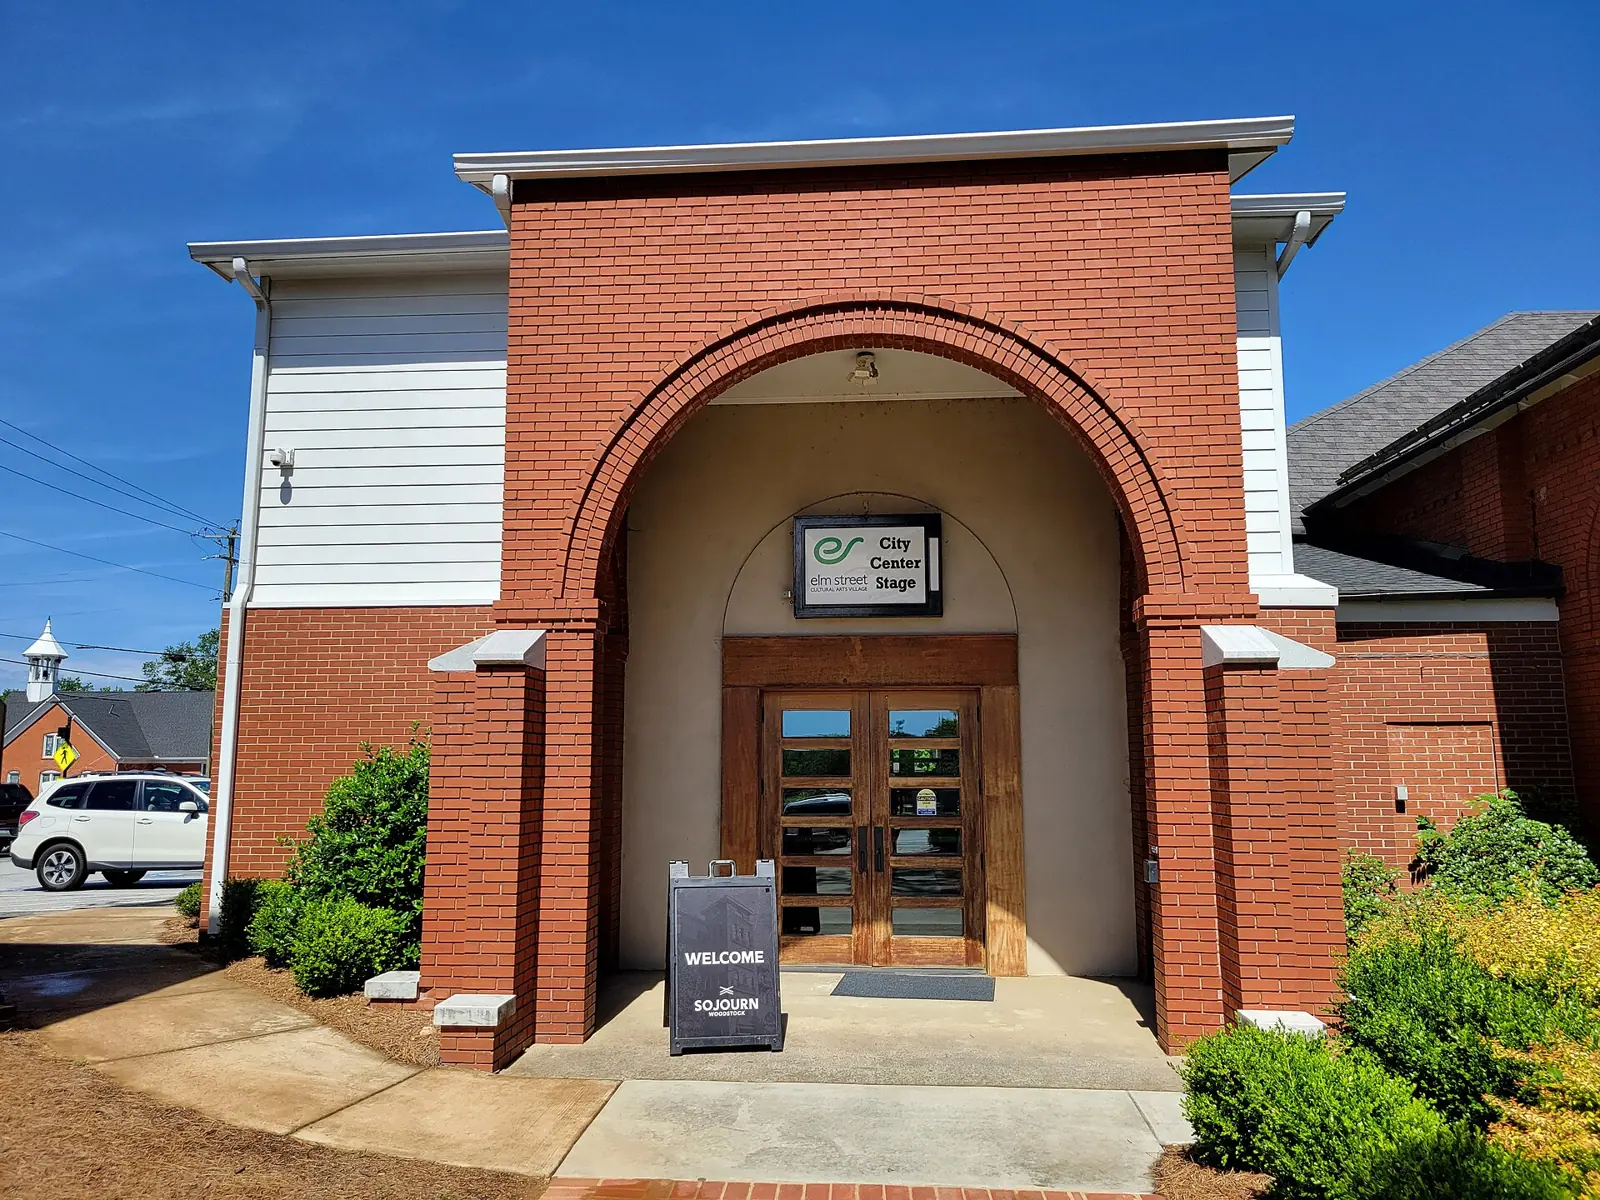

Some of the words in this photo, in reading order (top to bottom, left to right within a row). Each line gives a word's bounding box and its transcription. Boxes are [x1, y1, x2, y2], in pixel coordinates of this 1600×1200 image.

[879, 536, 911, 552] City
[870, 556, 921, 570] Center
[810, 573, 832, 586] elm
[834, 574, 869, 586] street
[875, 576, 917, 593] Stage
[684, 950, 765, 966] WELCOME
[694, 997, 759, 1012] SOJOURN
